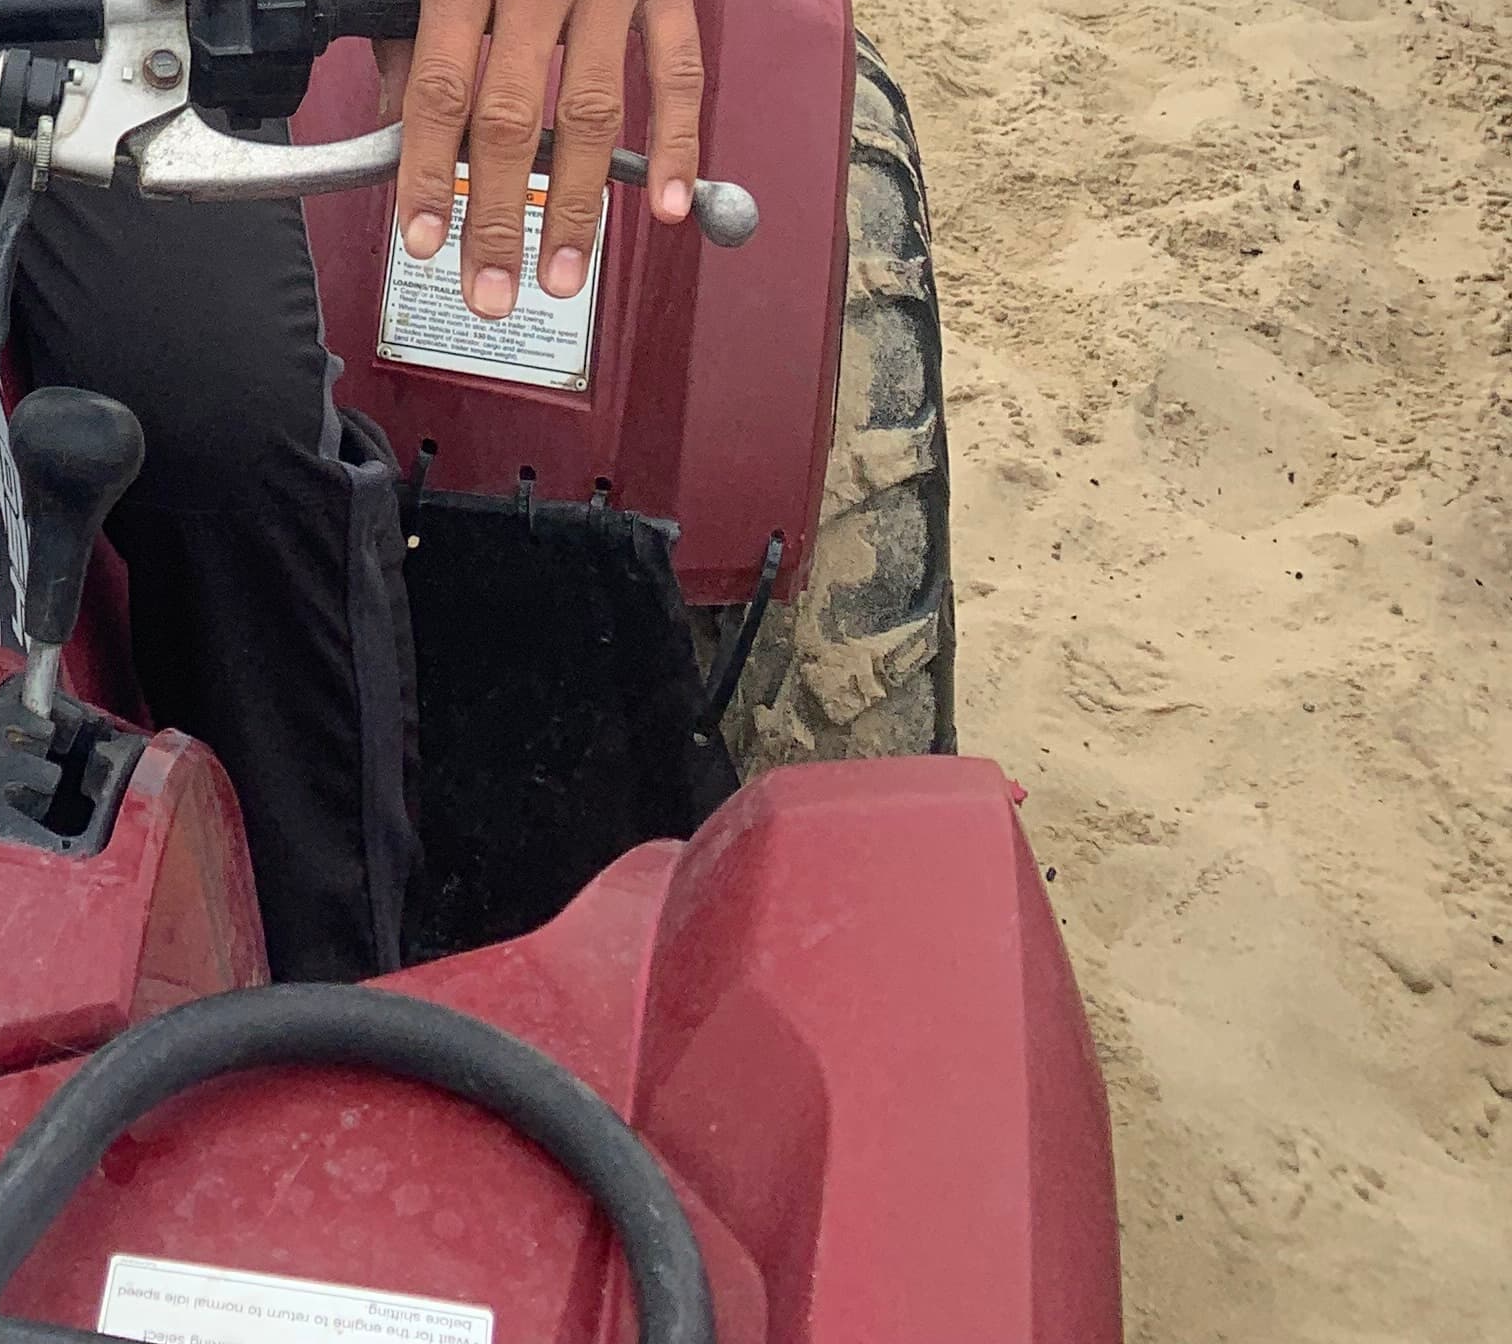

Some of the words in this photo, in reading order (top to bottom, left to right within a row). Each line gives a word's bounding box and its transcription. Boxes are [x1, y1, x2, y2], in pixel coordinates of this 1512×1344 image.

[117, 1285, 161, 1301] speed
[165, 1293, 191, 1306] idle
[193, 1295, 244, 1313] normal
[248, 1305, 262, 1318] to
[267, 1307, 310, 1324] return
[314, 1314, 329, 1328] to
[334, 1318, 382, 1334] engine
[425, 1315, 473, 1332] before
[386, 1326, 409, 1340] the
[416, 1329, 434, 1343] for
